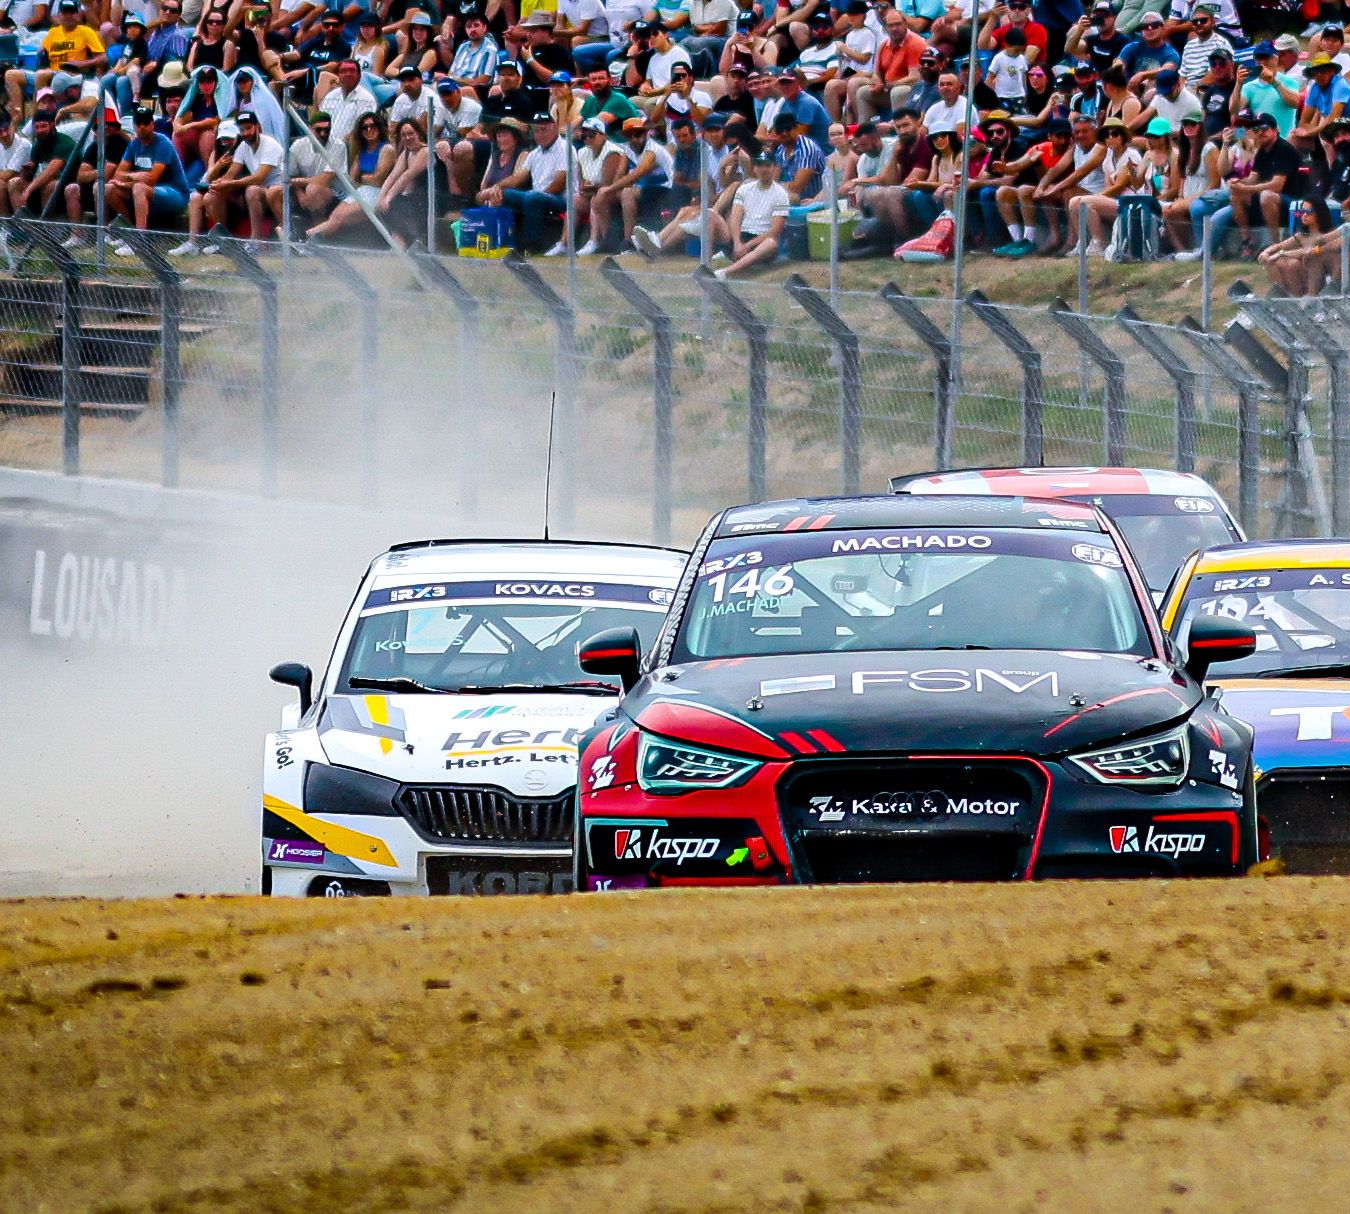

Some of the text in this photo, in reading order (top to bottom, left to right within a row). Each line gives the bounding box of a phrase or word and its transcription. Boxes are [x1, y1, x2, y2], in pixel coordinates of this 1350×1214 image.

[1177, 498, 1212, 512] FIA
[831, 536, 992, 552] MACHADO
[1075, 545, 1122, 566] FIA
[707, 563, 795, 603] 146
[1309, 574, 1335, 585] A.
[495, 583, 596, 597] KOVACS
[851, 668, 1059, 697] FSM
[275, 746, 295, 770] Go!
[445, 755, 521, 770] Hertz.
[920, 799, 938, 814] &
[945, 798, 1020, 815] Motor
[646, 829, 721, 866] kispo
[1144, 826, 1206, 859] kispo
